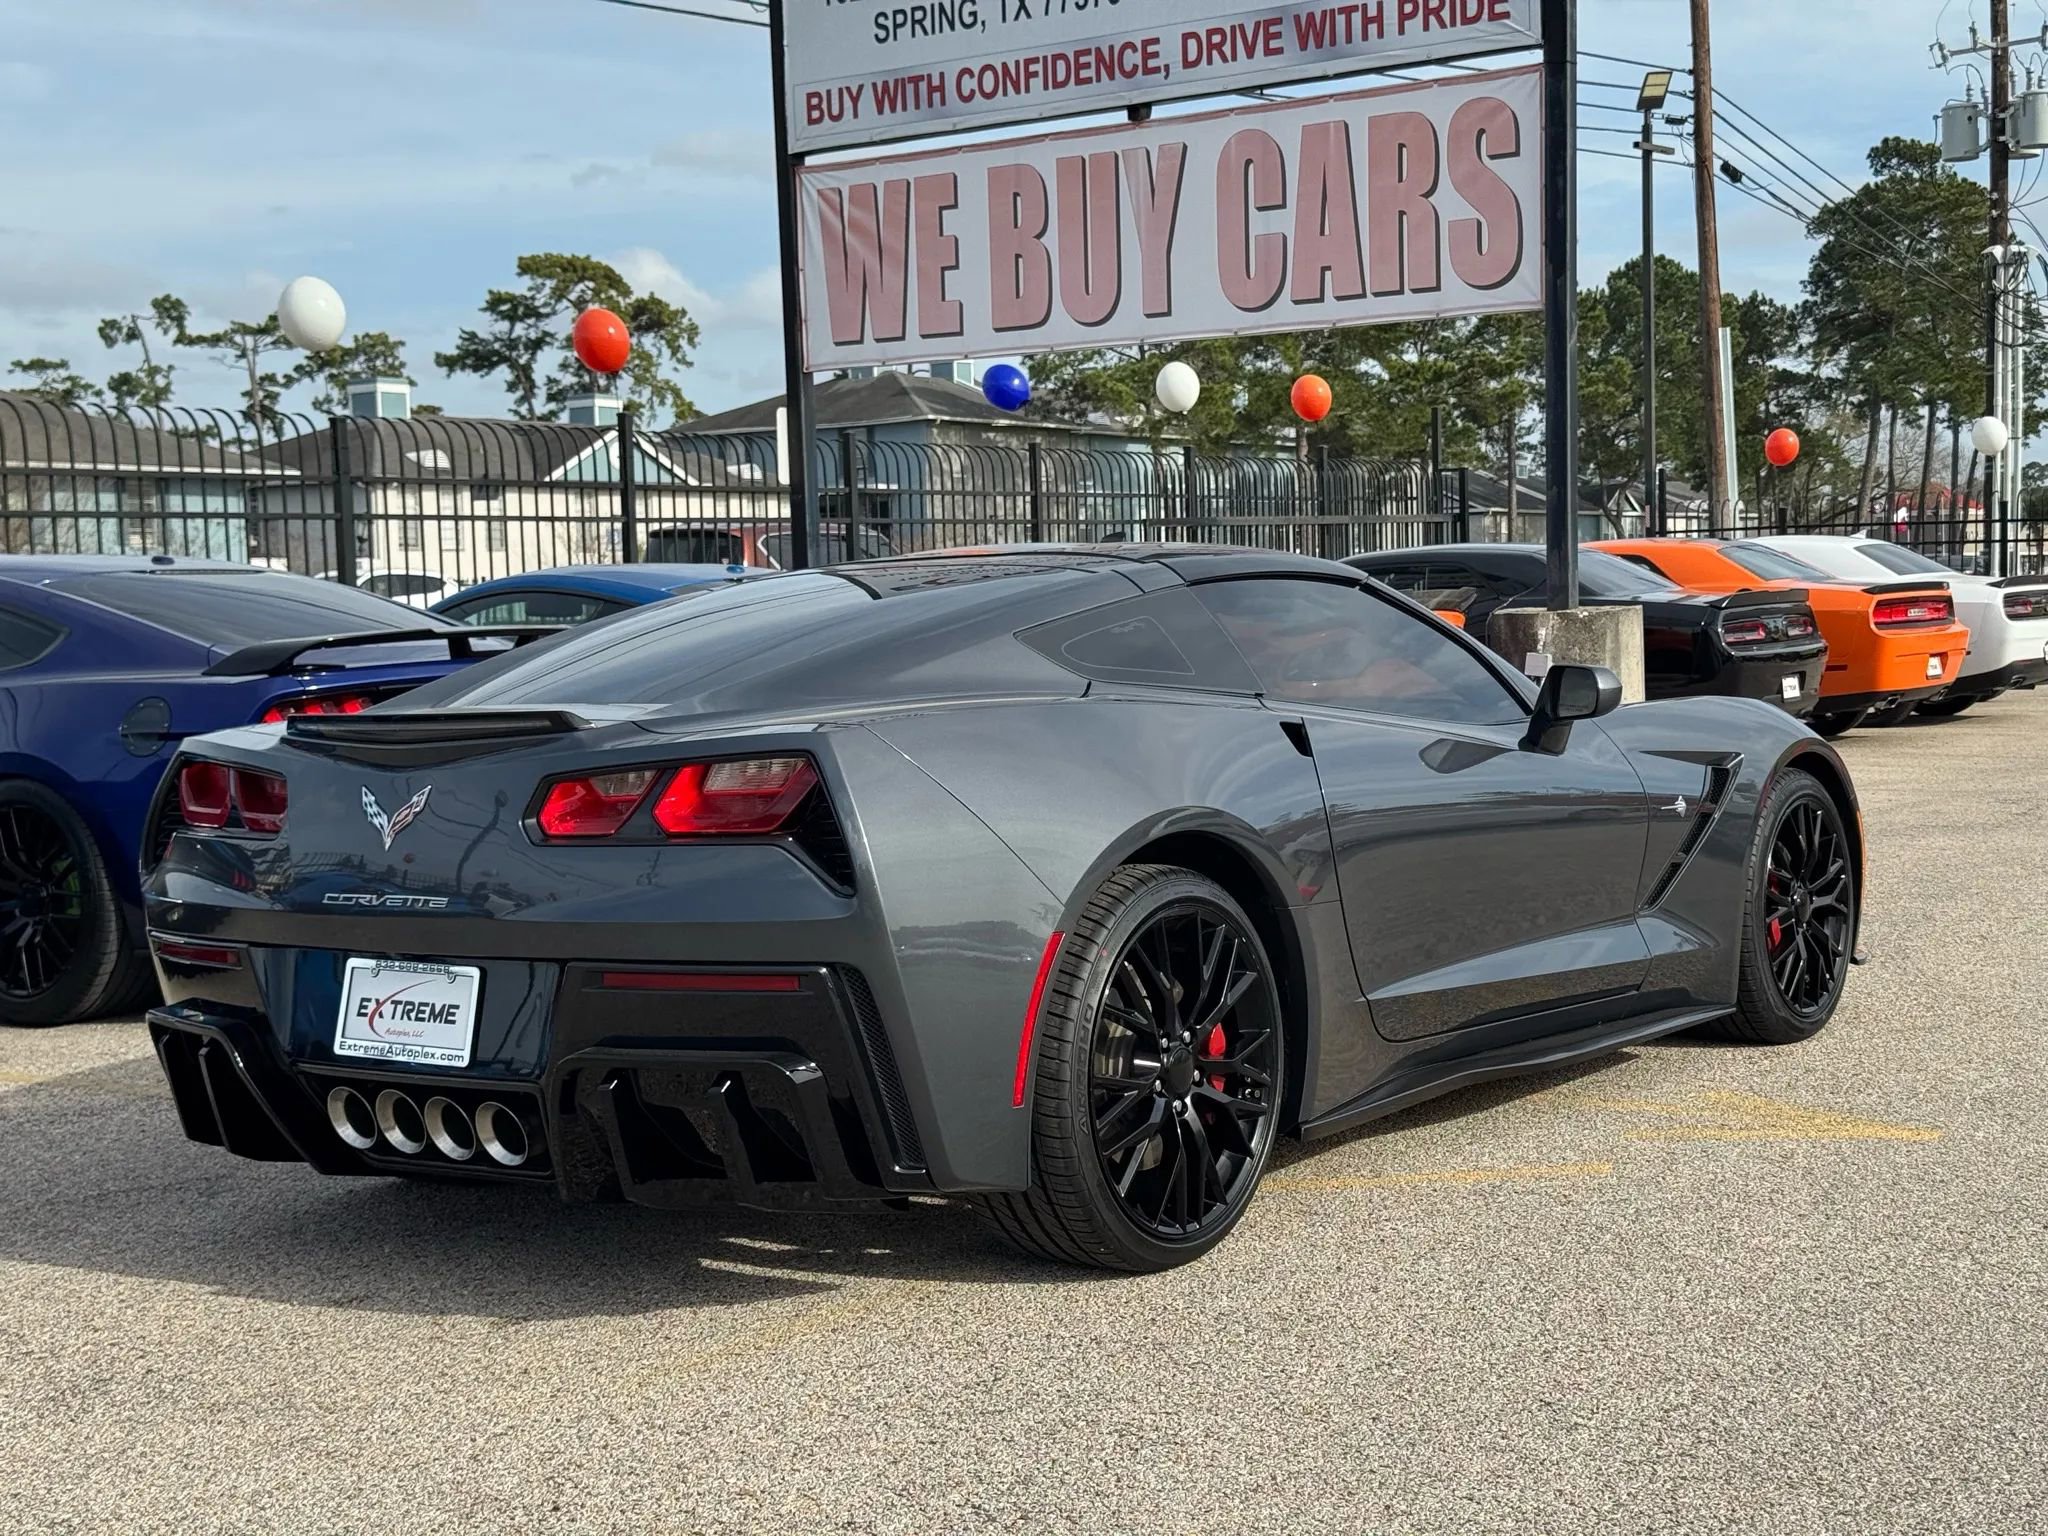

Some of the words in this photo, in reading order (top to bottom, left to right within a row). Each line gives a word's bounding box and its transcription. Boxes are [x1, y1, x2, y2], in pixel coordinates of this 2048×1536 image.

[873, 0, 987, 44] SPRING,
[805, 83, 865, 126] BUY
[871, 71, 947, 116] WITH
[955, 37, 1171, 104] CONFIDENCE,
[1181, 16, 1285, 71] DRIVE
[1293, 0, 1385, 52] WITH
[1396, 0, 1512, 36] PRIDE
[816, 171, 964, 347] WE
[987, 140, 1188, 334] BUY
[1215, 96, 1522, 312] CARS
[321, 892, 450, 909] CORVETTE
[356, 996, 461, 1026] EXTREME
[339, 1040, 465, 1063] ExtremeAutoplex.com
